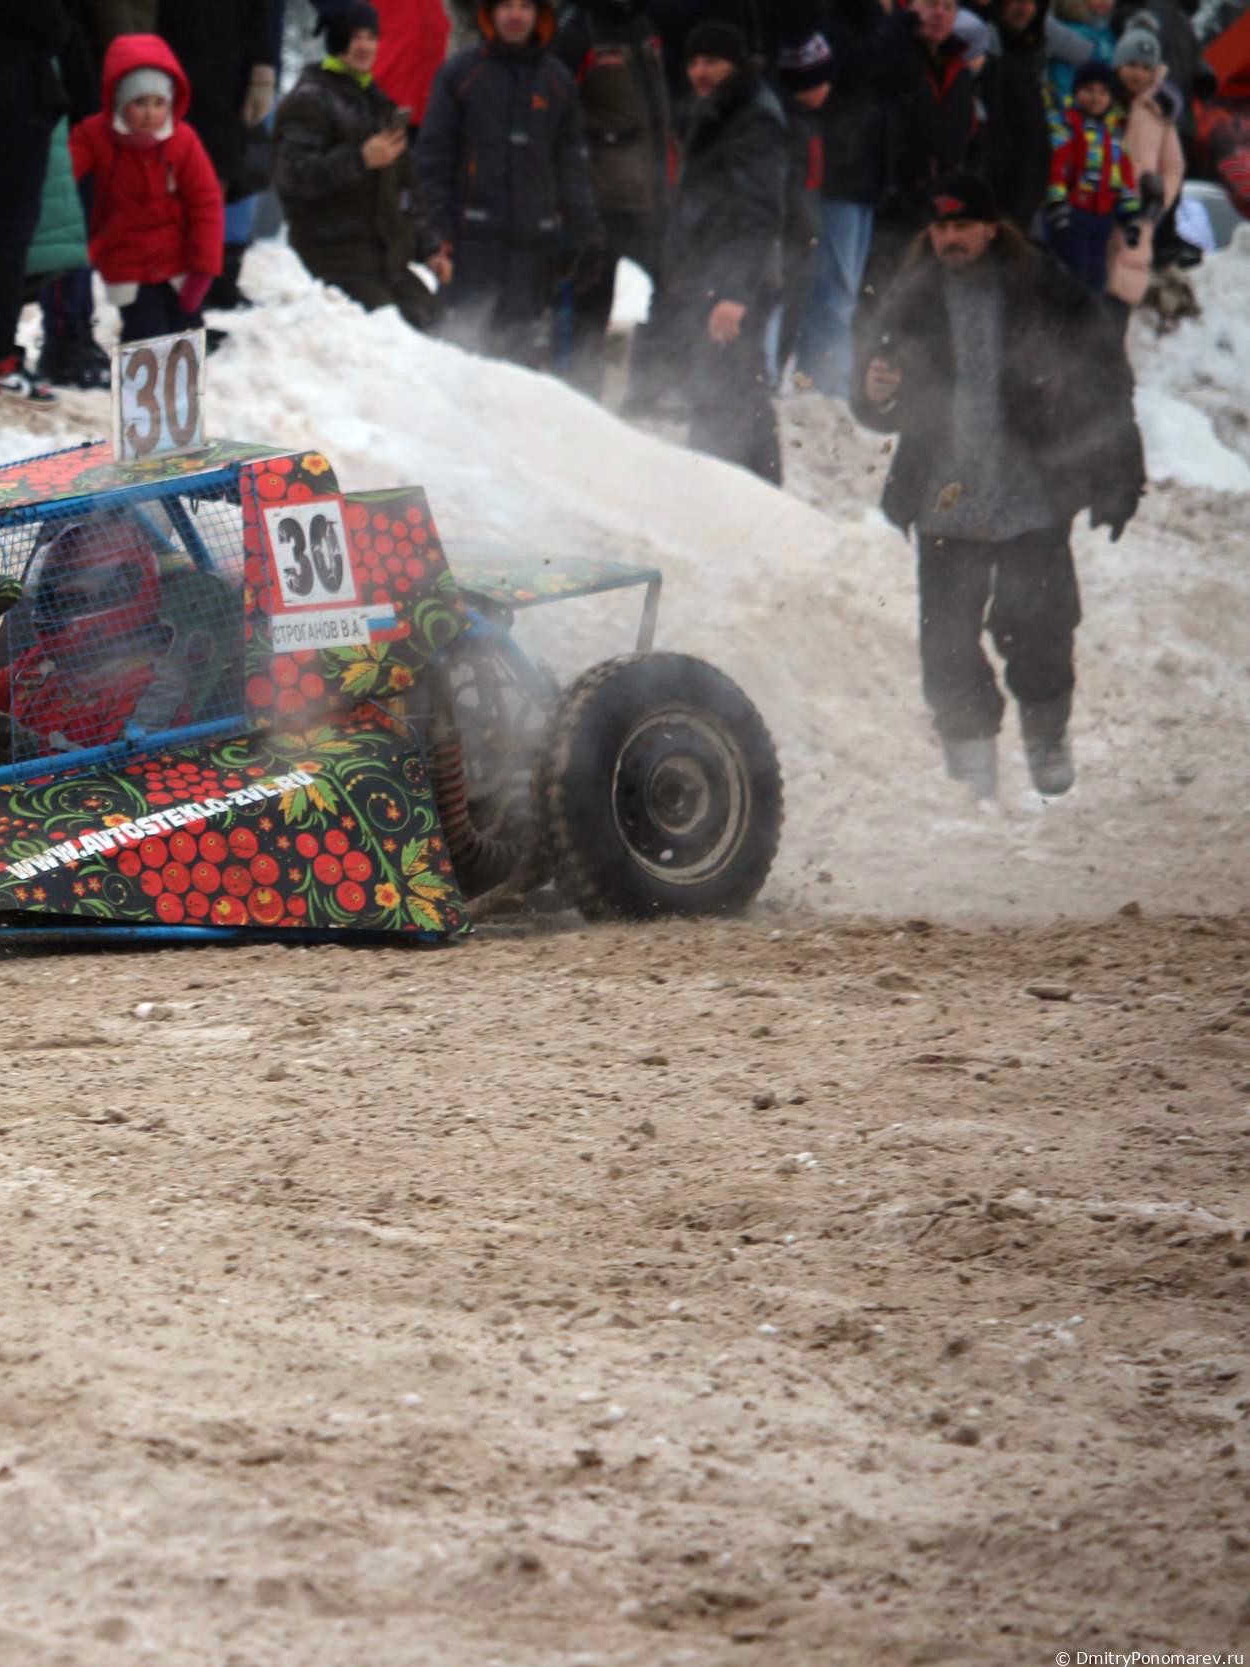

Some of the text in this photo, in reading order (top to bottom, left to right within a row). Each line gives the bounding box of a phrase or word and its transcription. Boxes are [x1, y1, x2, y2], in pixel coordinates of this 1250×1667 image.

[125, 338, 199, 455] 30
[277, 514, 344, 597] 30
[272, 619, 363, 645] СТРОГАНОВ В.А.
[6, 769, 315, 880] WWW.AVTOSTEKLO-ZVL.RU
